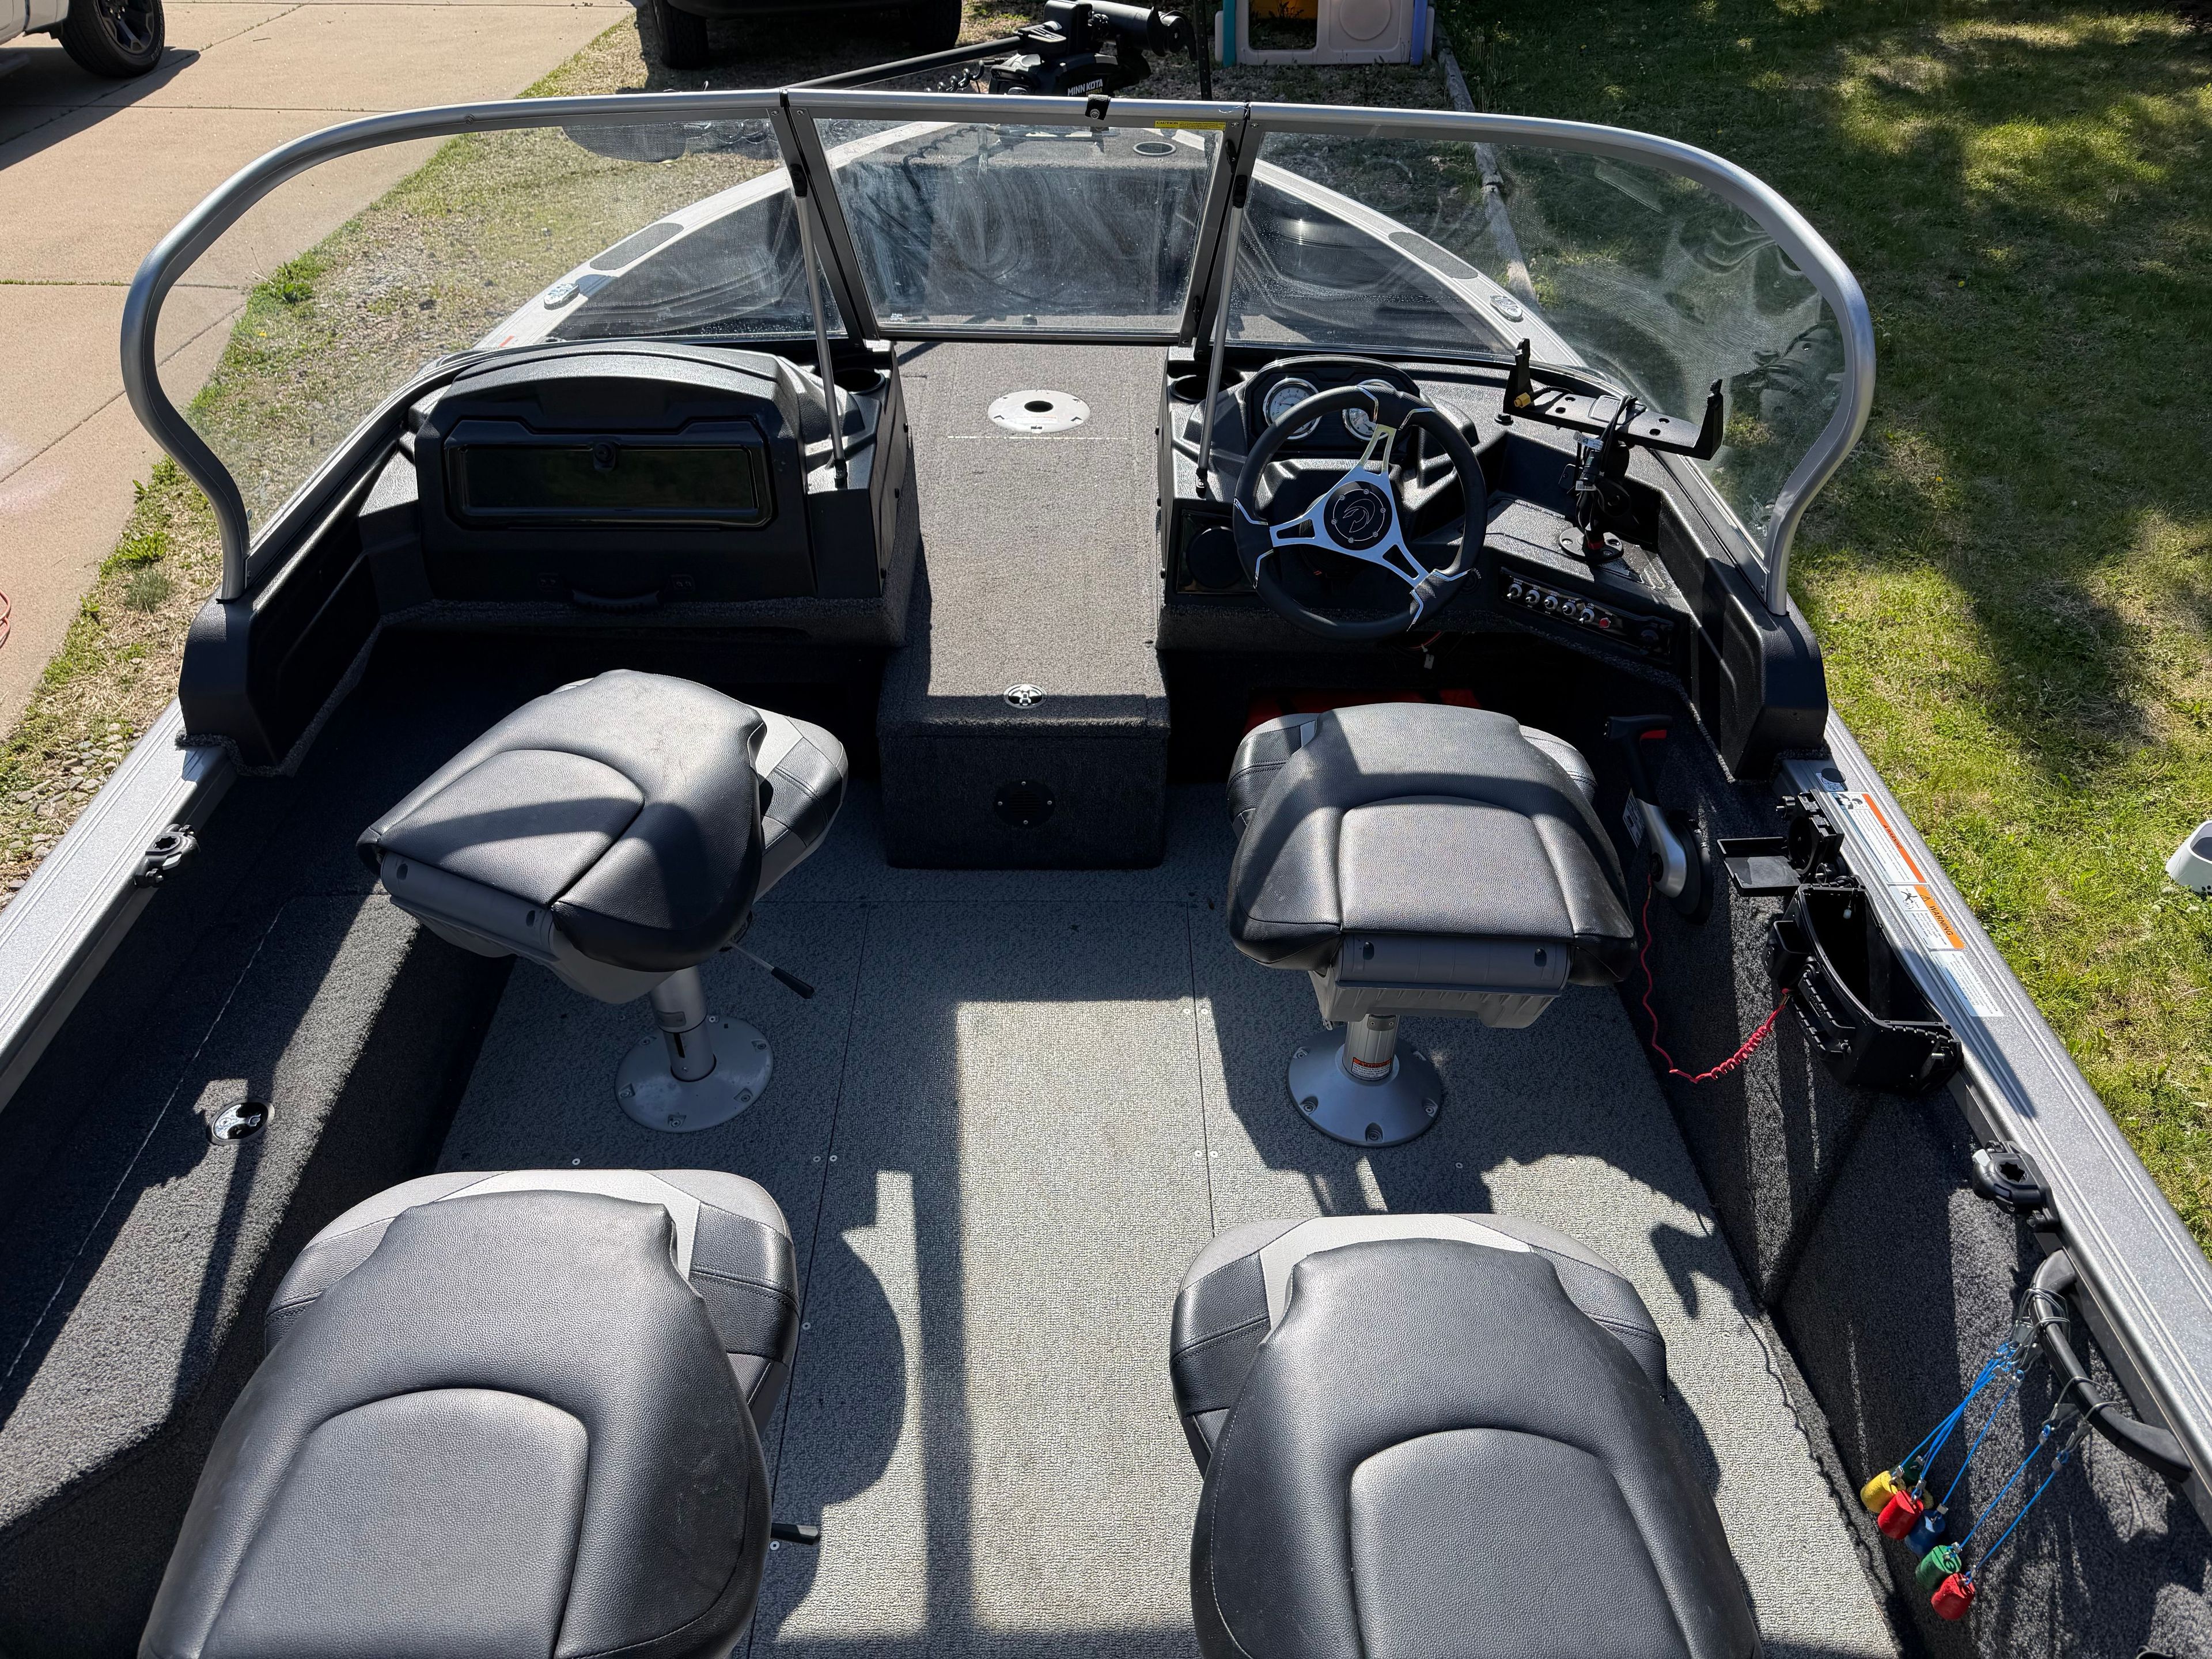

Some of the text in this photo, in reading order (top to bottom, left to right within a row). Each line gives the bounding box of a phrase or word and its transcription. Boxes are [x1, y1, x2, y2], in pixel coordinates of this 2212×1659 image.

[1067, 78, 1103, 96] MINN KOTA
[1887, 828, 1903, 849] WARNING
[1929, 906, 1953, 935] WARNING
